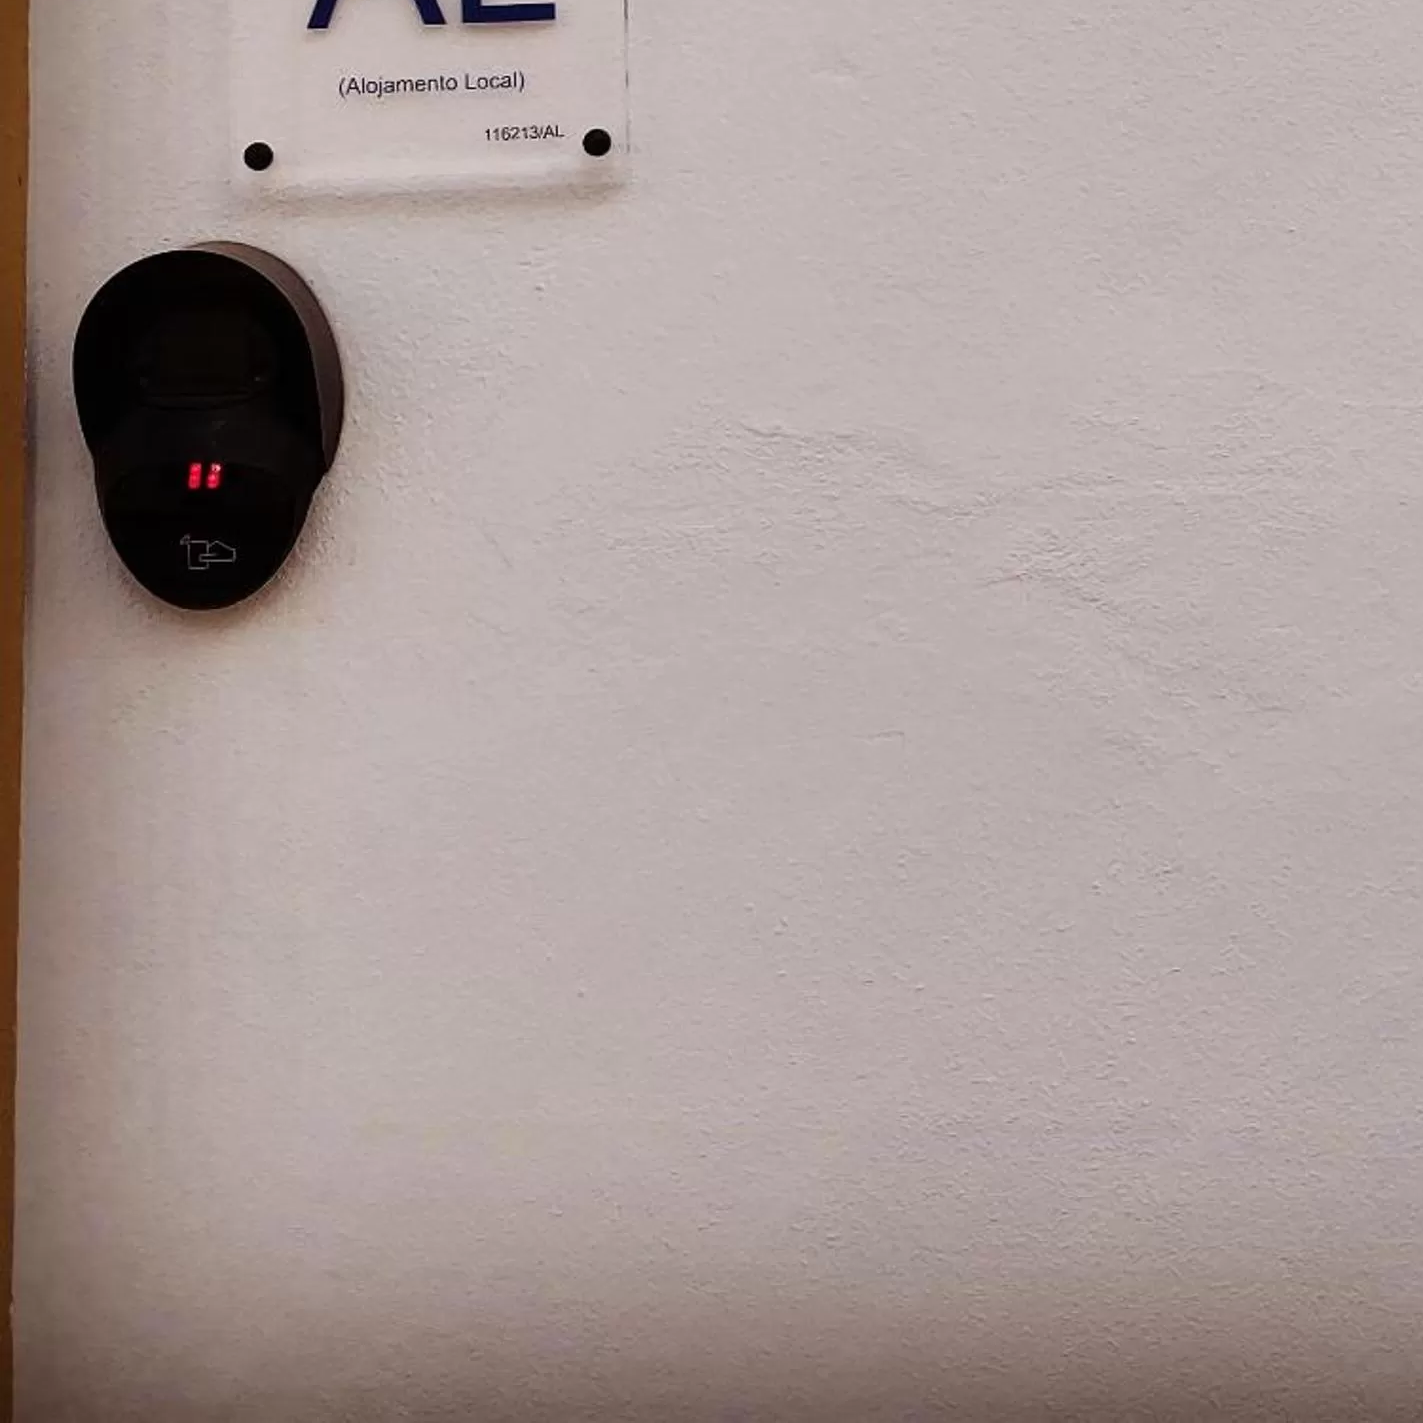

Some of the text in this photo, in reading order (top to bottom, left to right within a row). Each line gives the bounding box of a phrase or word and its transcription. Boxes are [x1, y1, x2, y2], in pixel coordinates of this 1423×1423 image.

[339, 71, 525, 99] (Alojamento Local)
[485, 124, 565, 141] 116213/AL
